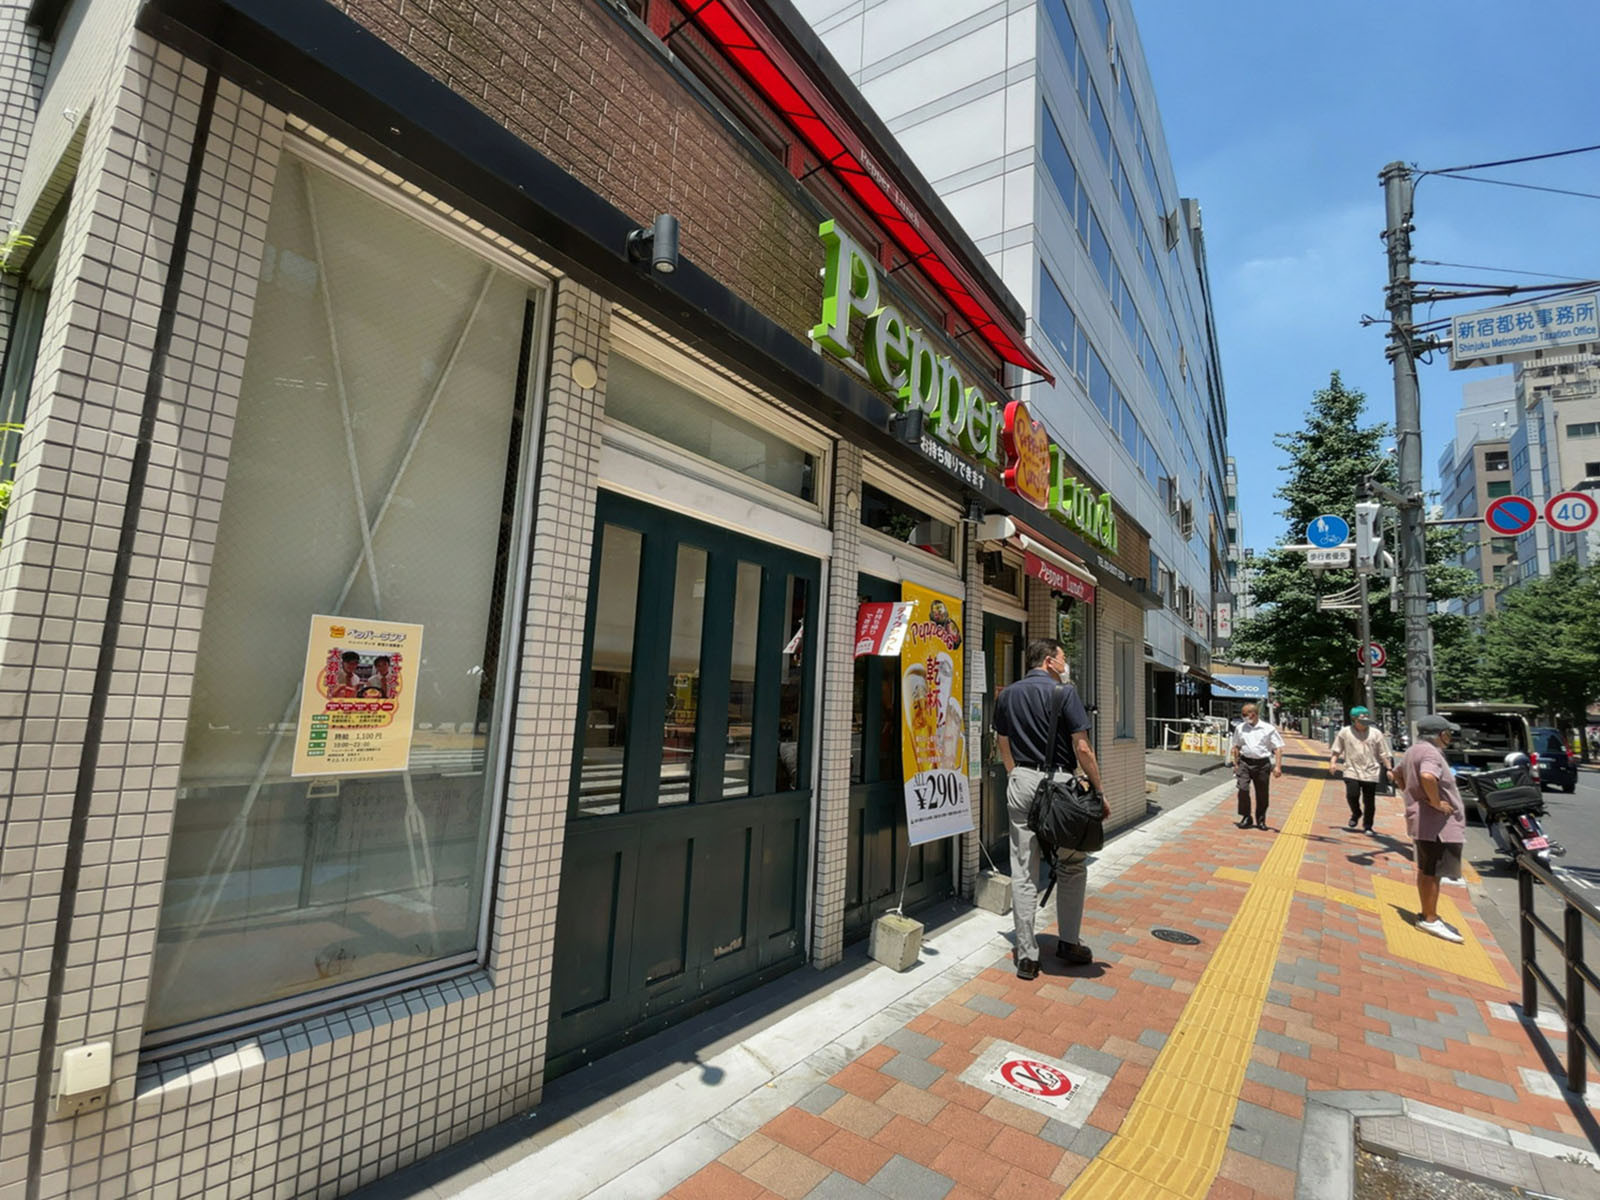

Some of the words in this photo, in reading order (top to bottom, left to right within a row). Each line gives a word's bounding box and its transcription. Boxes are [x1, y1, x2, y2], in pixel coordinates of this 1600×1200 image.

[1458, 302, 1594, 339] 新宿都税事務所
[1460, 341, 1490, 353] Shinjuku
[1491, 334, 1537, 348] Metropolitan
[1539, 328, 1572, 341] Taxation
[1573, 324, 1596, 337] Office
[813, 219, 1004, 466] Pepper
[920, 435, 985, 489] お持ち帰りできます
[1557, 503, 1586, 520] 40
[1038, 560, 1064, 588] Pepper
[914, 772, 958, 810] ¥290
